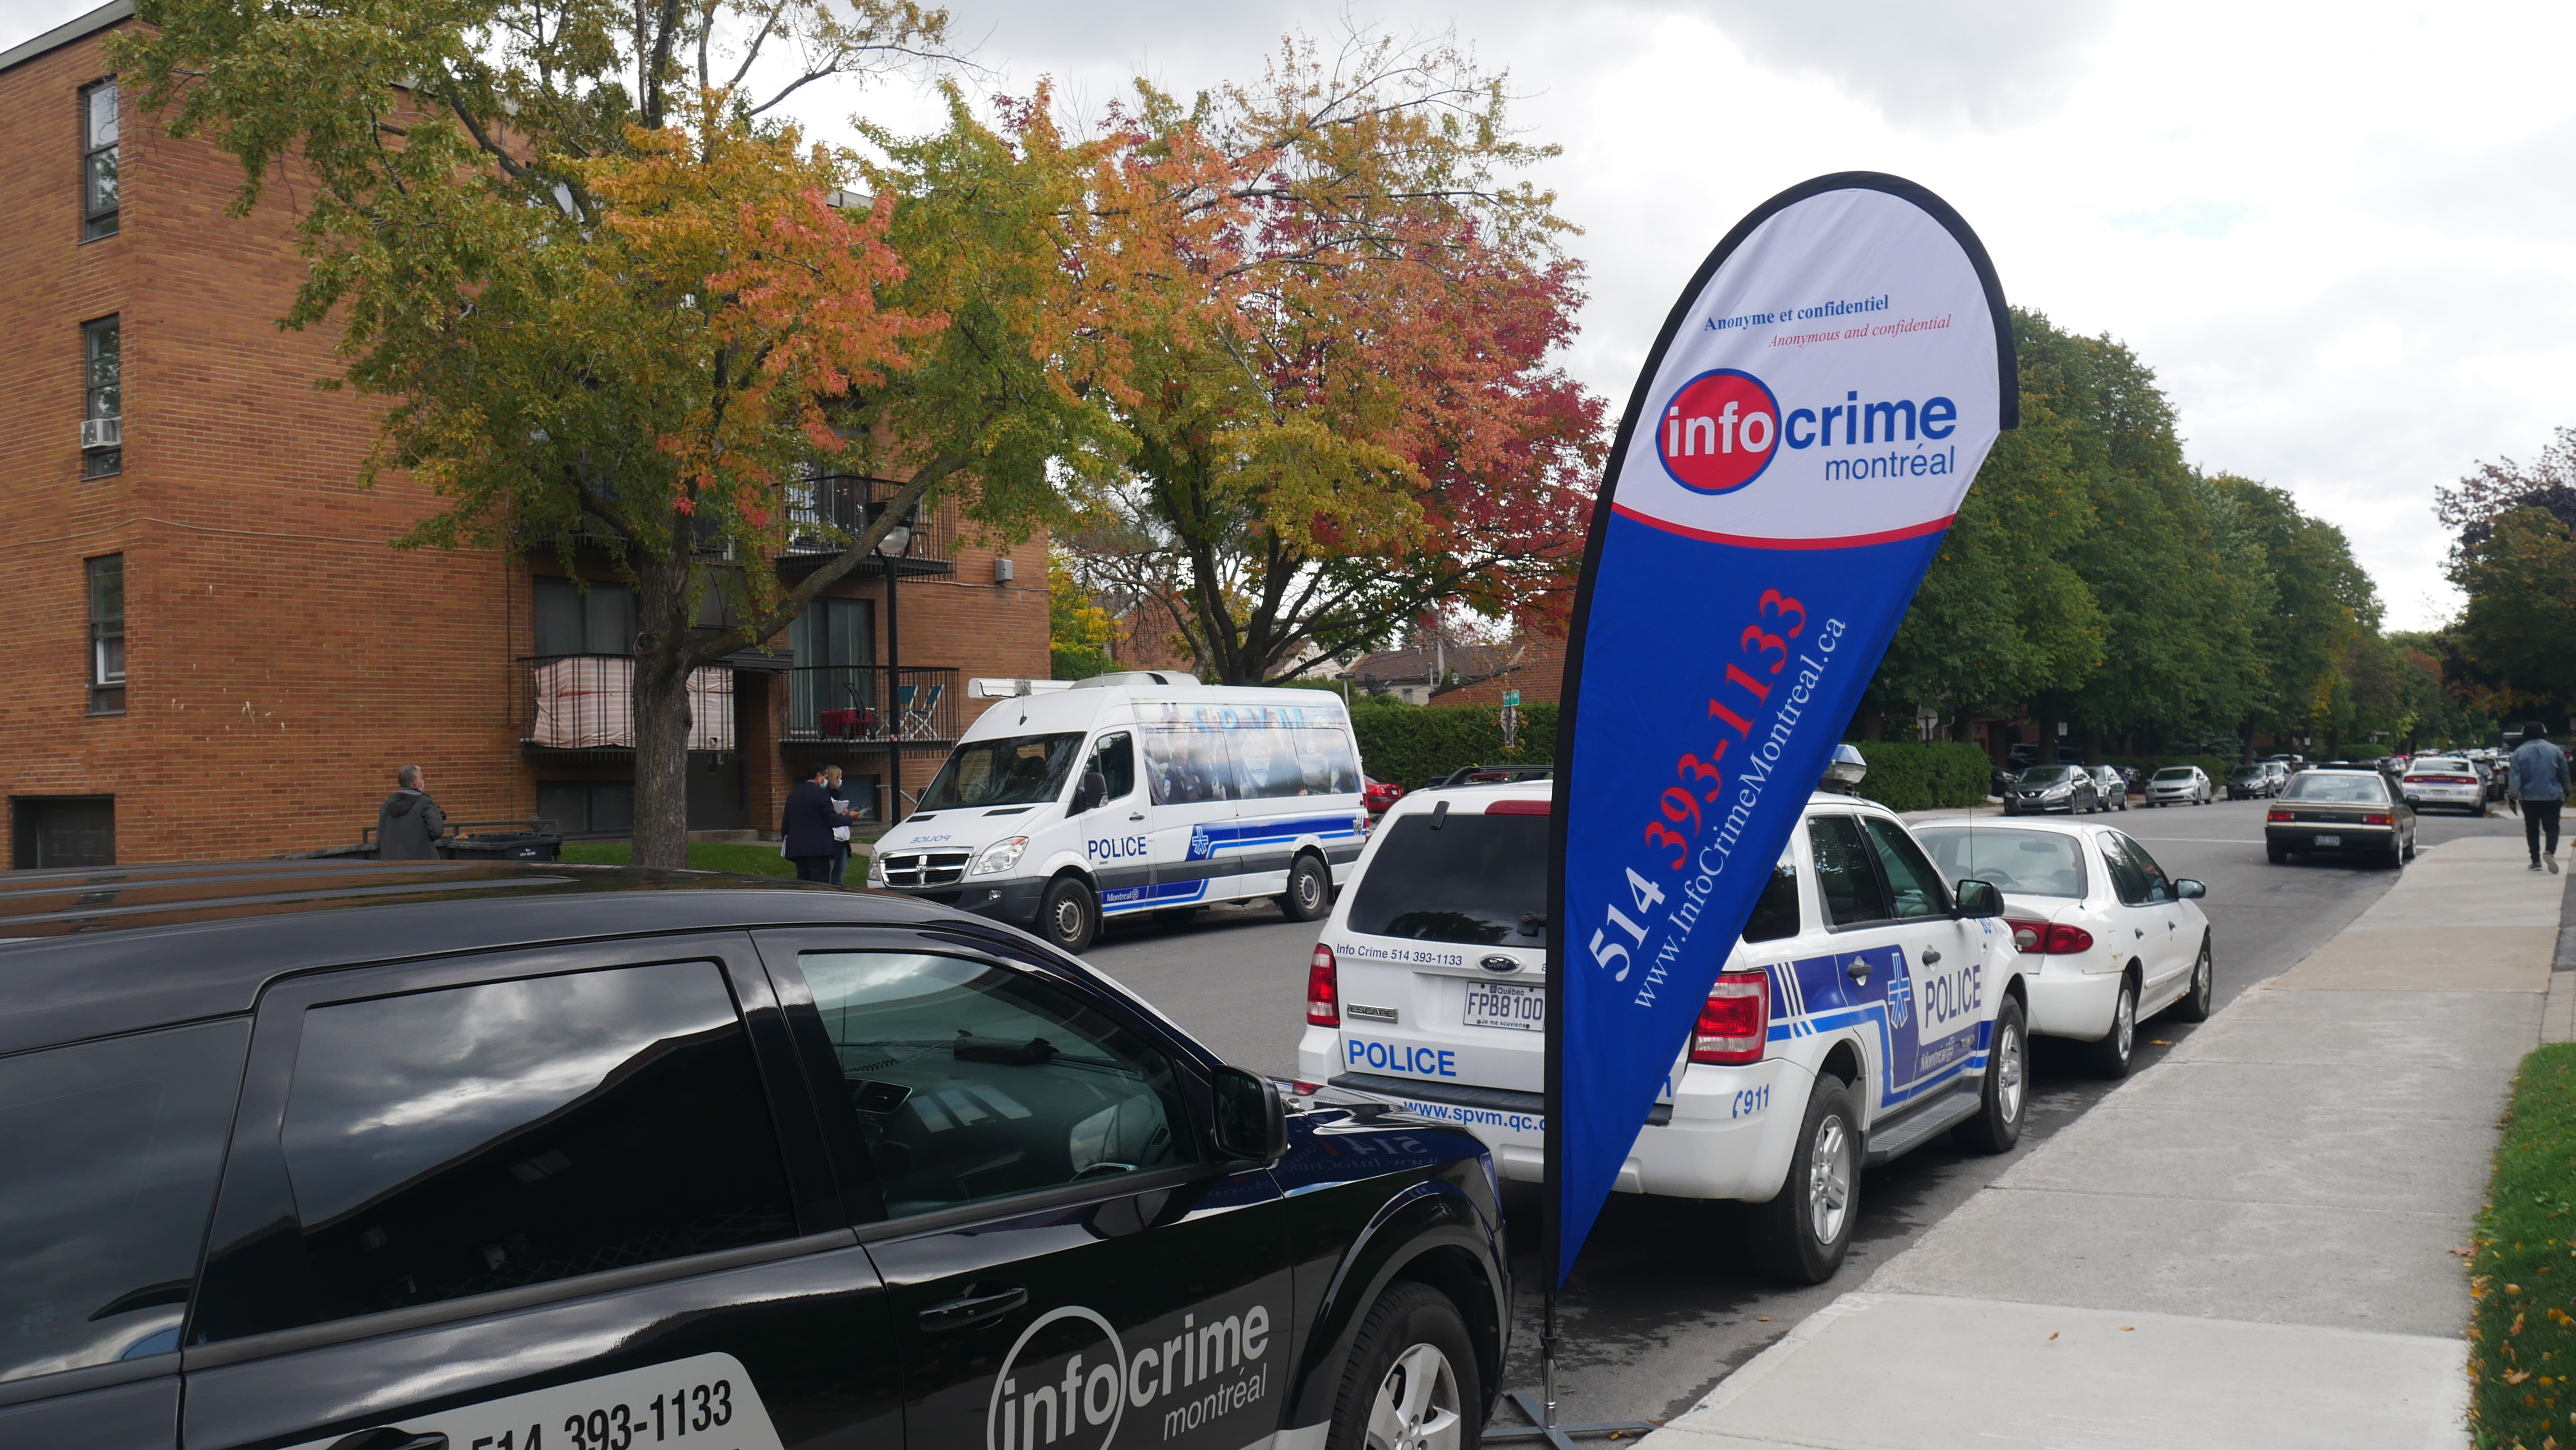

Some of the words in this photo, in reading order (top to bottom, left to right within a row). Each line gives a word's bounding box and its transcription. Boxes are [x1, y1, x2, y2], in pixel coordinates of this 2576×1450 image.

[1704, 309, 1774, 331] Anonyme
[1779, 307, 1793, 322] et
[1797, 295, 1889, 320] confidentiel
[1768, 329, 1841, 348] Anonymous
[1844, 321, 1869, 339] and
[1871, 314, 1952, 338] confidential
[1825, 443, 1955, 481] montréal
[1588, 866, 1666, 983] 514
[1644, 588, 1806, 871] 393-1133
[1634, 617, 1846, 1009] www.InfoCrimeMontreal.ca
[1088, 836, 1147, 860] POLICE
[1336, 943, 1355, 956] Info
[1358, 946, 1388, 958] Crime
[1391, 949, 1410, 961] 514
[1413, 951, 1463, 966] 393-1133
[1497, 987, 1525, 996] Québec
[1925, 964, 1981, 1029] POLICE
[1350, 1006, 1394, 1017] ESCAPE
[1349, 1040, 1456, 1077] POLICE
[1744, 1083, 1769, 1115] 911
[1163, 1362, 1267, 1441] montréal
